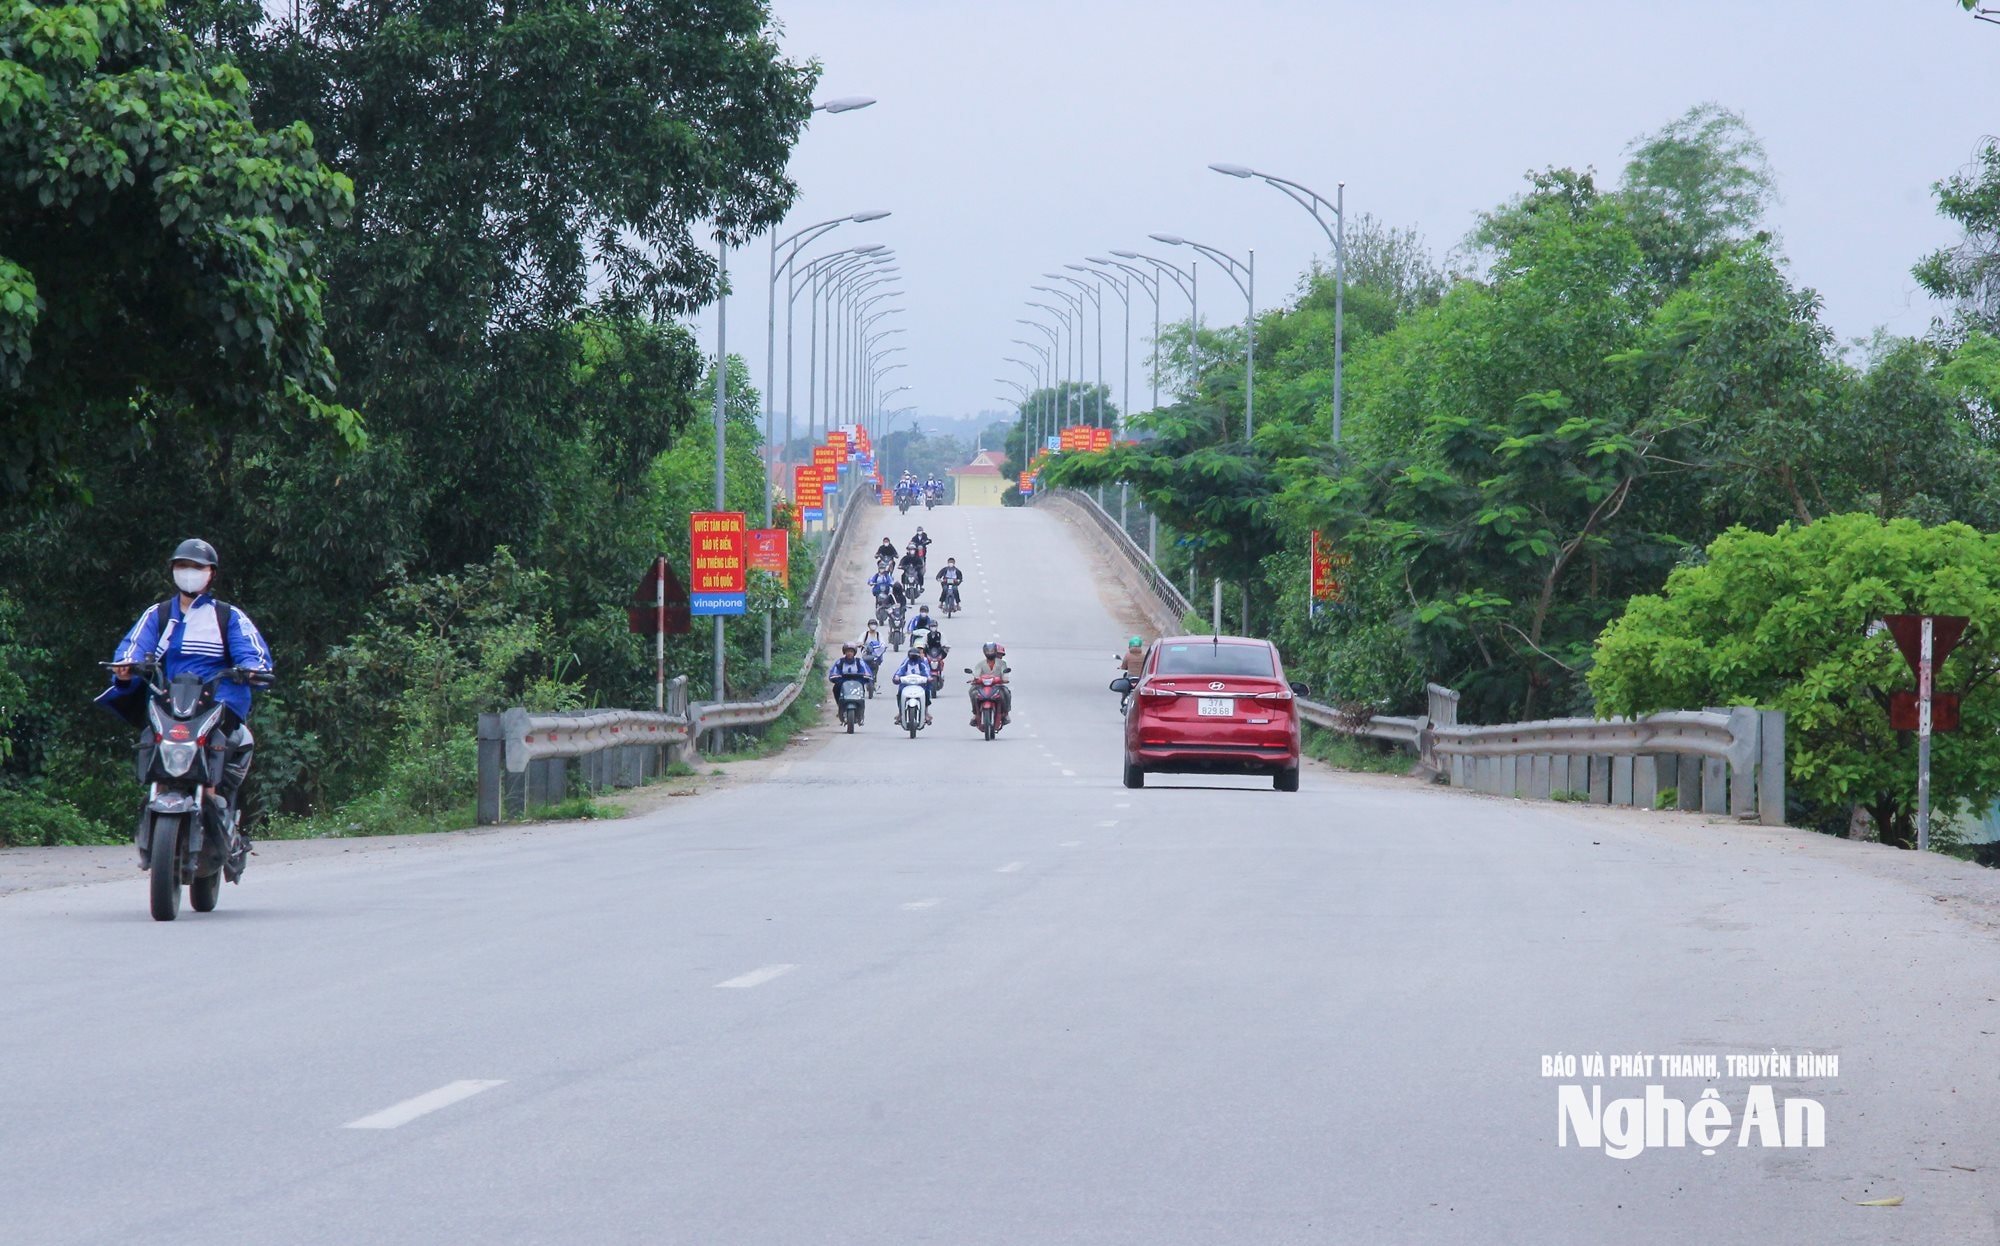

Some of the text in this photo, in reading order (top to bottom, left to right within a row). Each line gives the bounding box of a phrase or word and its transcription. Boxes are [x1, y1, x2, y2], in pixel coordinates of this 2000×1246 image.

[702, 535, 712, 551] BẢO
[713, 536, 719, 552] VỆ
[694, 598, 742, 609] vinaphone
